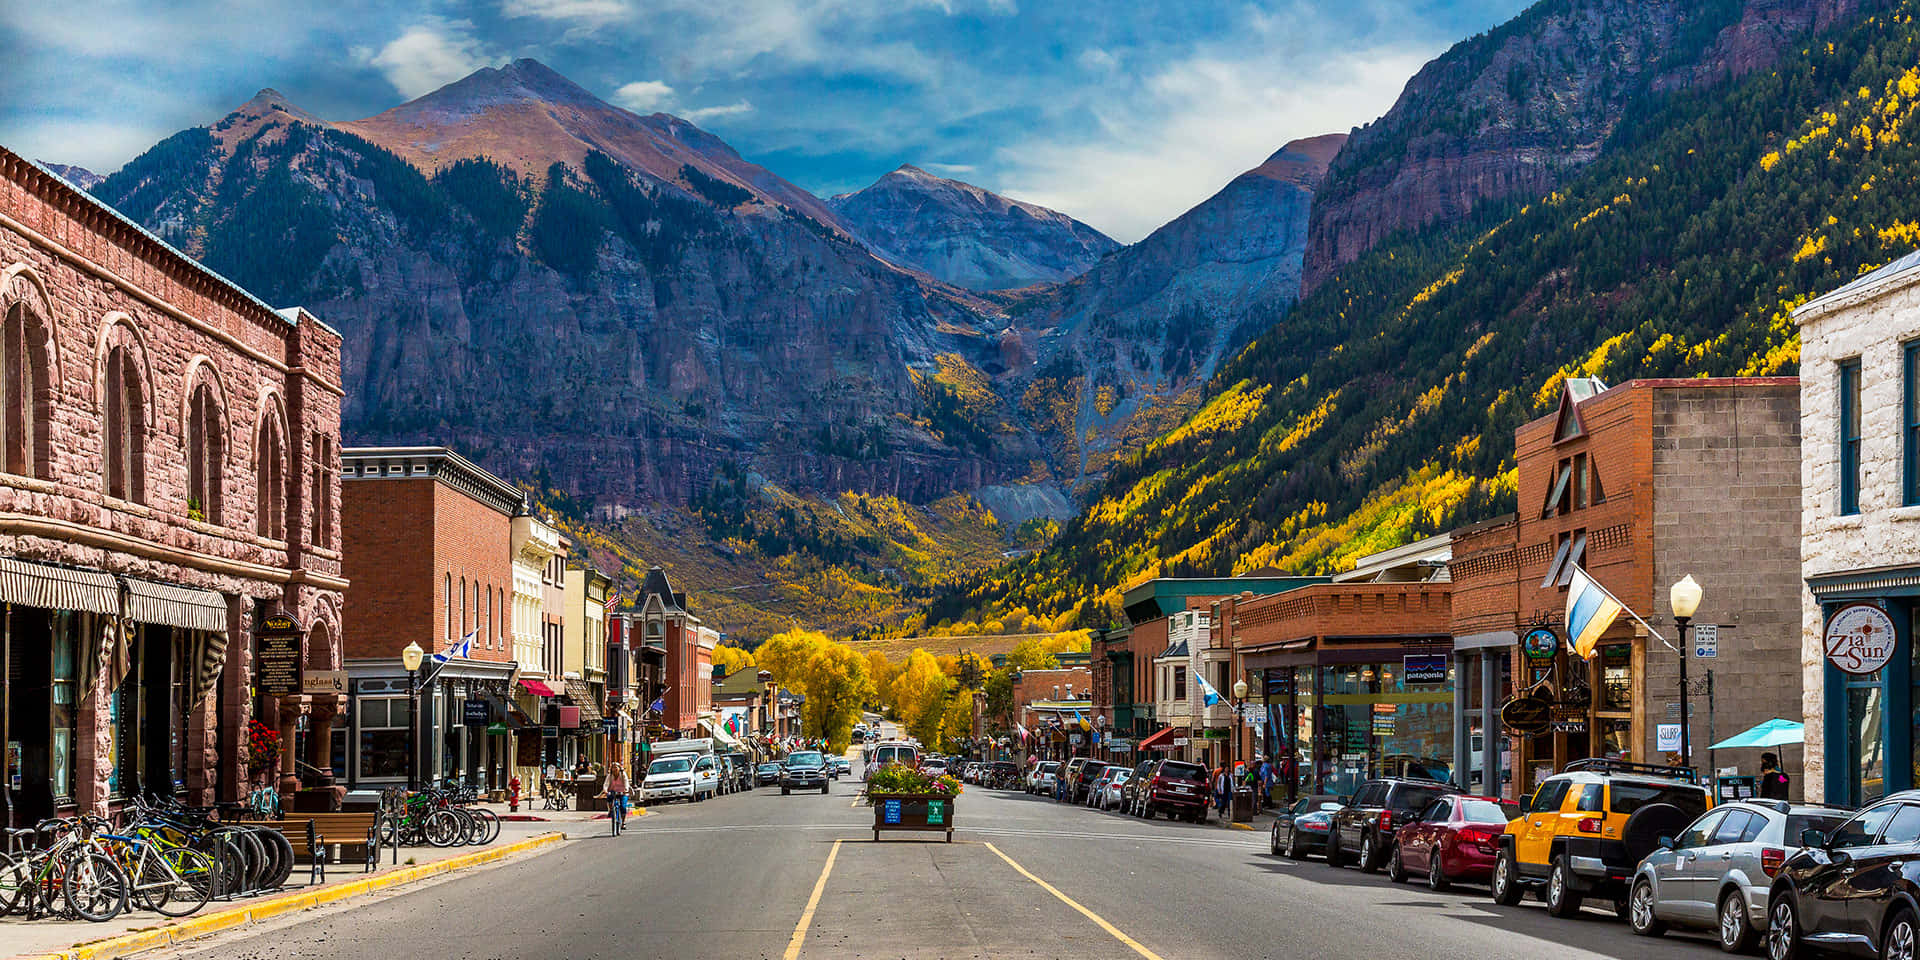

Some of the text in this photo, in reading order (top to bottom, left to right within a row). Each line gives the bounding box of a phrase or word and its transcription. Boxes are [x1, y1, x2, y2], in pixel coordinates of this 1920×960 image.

[1827, 631, 1864, 657] Zia
[1848, 646, 1885, 670] Sun
[304, 676, 333, 689] nglass
[1407, 671, 1444, 680] patagonia
